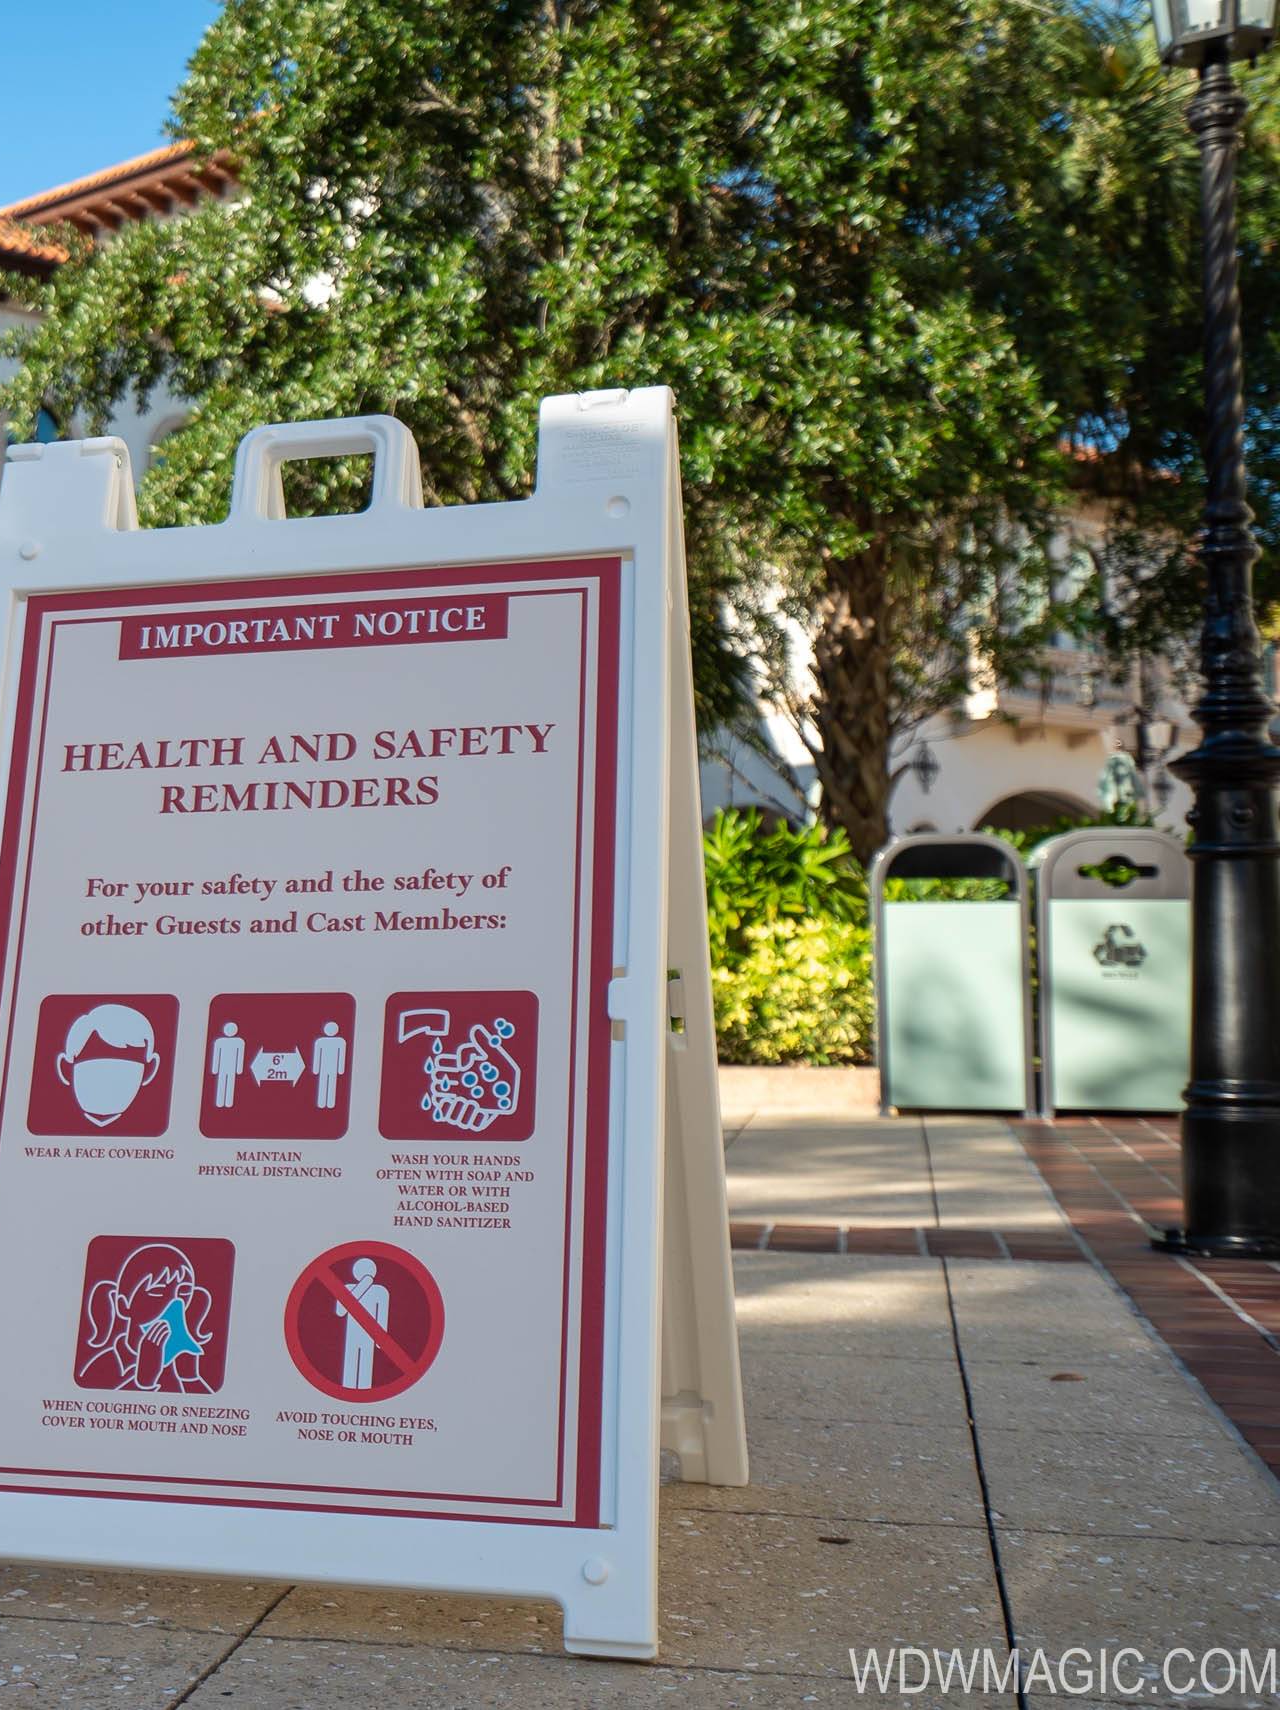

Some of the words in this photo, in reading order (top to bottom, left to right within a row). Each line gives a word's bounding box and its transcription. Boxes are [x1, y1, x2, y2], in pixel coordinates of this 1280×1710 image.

[140, 615, 340, 650] IMPORTANT
[353, 606, 486, 637] NOTICE
[61, 737, 246, 773] HEALTH
[257, 732, 357, 765] AND
[373, 723, 556, 760] SAFETY
[159, 775, 439, 814] REMINDERS
[85, 878, 129, 898] For
[133, 881, 195, 904] your
[201, 873, 278, 902] safety
[285, 870, 333, 894] and
[342, 869, 385, 892] the
[393, 867, 474, 897] safety
[481, 866, 512, 889] of
[80, 914, 149, 936] other
[155, 915, 241, 935] Guests
[249, 910, 298, 934] and
[306, 912, 366, 933] Cast
[373, 907, 507, 932] Members:
[272, 1054, 284, 1066] 6'
[267, 1068, 288, 1080] 2m
[24, 1147, 61, 1158] WEAR
[63, 1148, 72, 1158] A
[75, 1148, 106, 1159] FACE
[108, 1148, 174, 1160] COVERING
[236, 1151, 302, 1162] MAINTAIN
[391, 1154, 429, 1165] WASH
[432, 1154, 470, 1166] YOUR
[473, 1155, 521, 1166] HANDS
[198, 1165, 259, 1177] PHYSICAL
[262, 1166, 342, 1178] DISTANCING
[376, 1169, 422, 1181] OFTEN
[425, 1169, 464, 1181] WITH
[467, 1170, 502, 1182] SOAP
[504, 1171, 535, 1182] AND
[397, 1184, 445, 1196] WATER
[448, 1185, 468, 1197] OR
[471, 1186, 510, 1198] WITH
[397, 1200, 510, 1213] ALCOHOL-BASED
[393, 1215, 434, 1227] HAND
[436, 1216, 512, 1229] SANITIZER
[42, 1399, 83, 1412] WHEN
[85, 1401, 157, 1416] COUGHING
[159, 1405, 179, 1417] OR
[181, 1406, 250, 1421] SNEEZING
[41, 1415, 86, 1428] COVER
[89, 1417, 124, 1430] YOUR
[127, 1419, 177, 1433] MOUTH
[179, 1422, 209, 1434] AND
[211, 1423, 247, 1437] NOSE
[275, 1411, 318, 1424] AVOID
[320, 1413, 396, 1428] TOUCHING
[399, 1417, 438, 1433] EYES,
[298, 1428, 334, 1441] NOSE
[337, 1430, 357, 1443] OR
[360, 1431, 413, 1446] MOUTH
